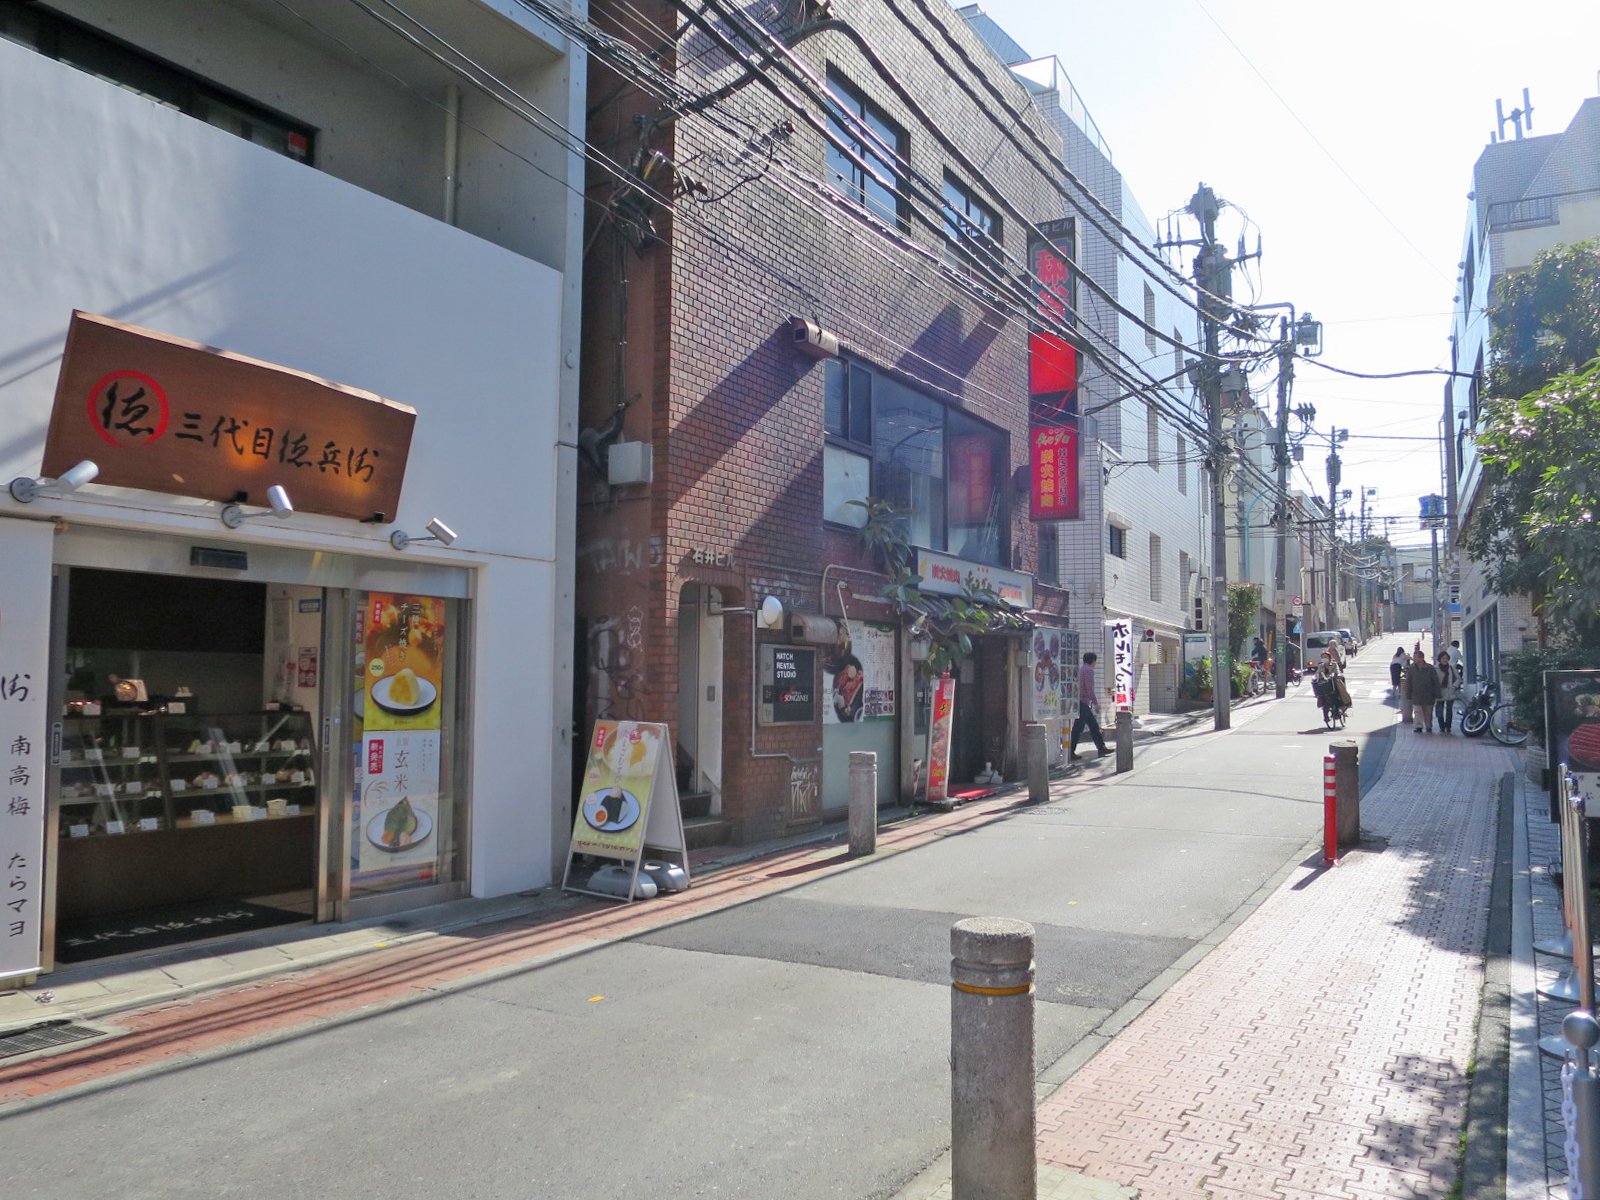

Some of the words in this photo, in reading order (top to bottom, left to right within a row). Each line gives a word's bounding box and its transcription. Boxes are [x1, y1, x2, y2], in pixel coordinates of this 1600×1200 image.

[1041, 220, 1072, 234] 井ビル
[1041, 449, 1054, 507] 炭火焼肉
[692, 548, 736, 568] 石井ビル
[776, 662, 796, 670] RENTAL
[776, 670, 797, 679] STUDIO
[370, 742, 378, 771] 新発売
[394, 749, 410, 792] 玄米
[7, 735, 31, 816] 南高梅
[7, 852, 28, 938] たらマヨ
